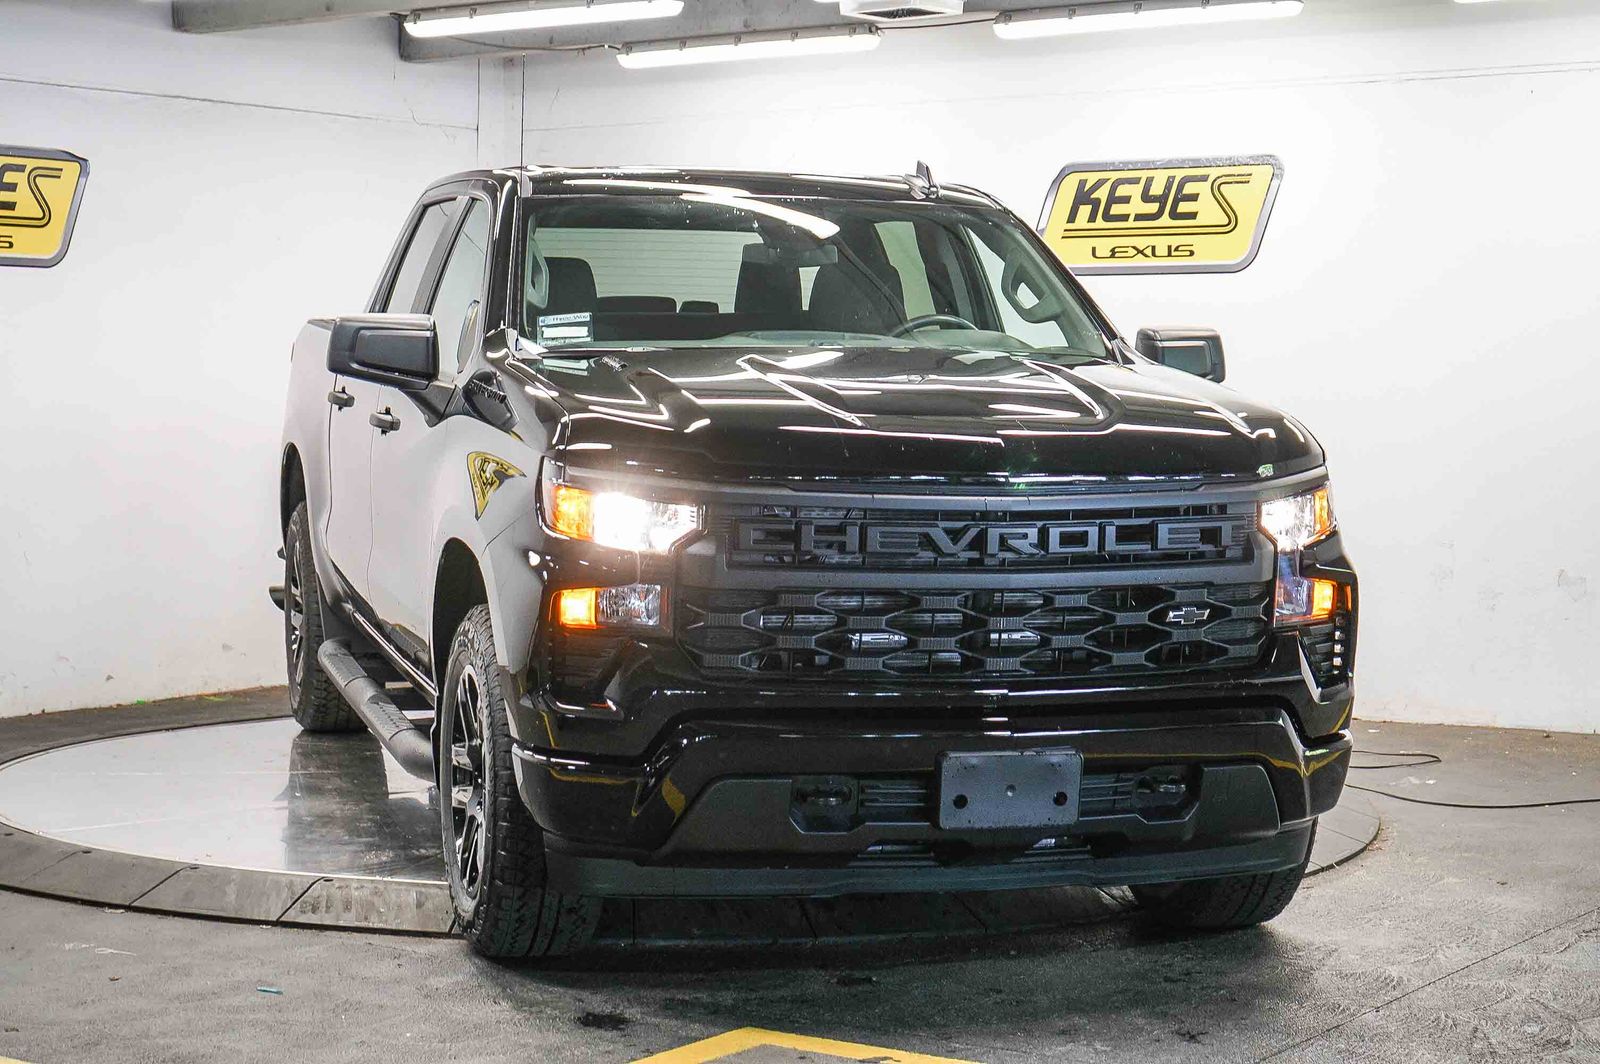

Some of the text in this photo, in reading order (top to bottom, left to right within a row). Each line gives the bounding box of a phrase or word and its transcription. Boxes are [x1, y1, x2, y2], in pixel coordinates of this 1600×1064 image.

[1062, 173, 1253, 236] KEYES
[1092, 243, 1196, 260] LEXUS
[737, 517, 1243, 557] CHEVROLET
